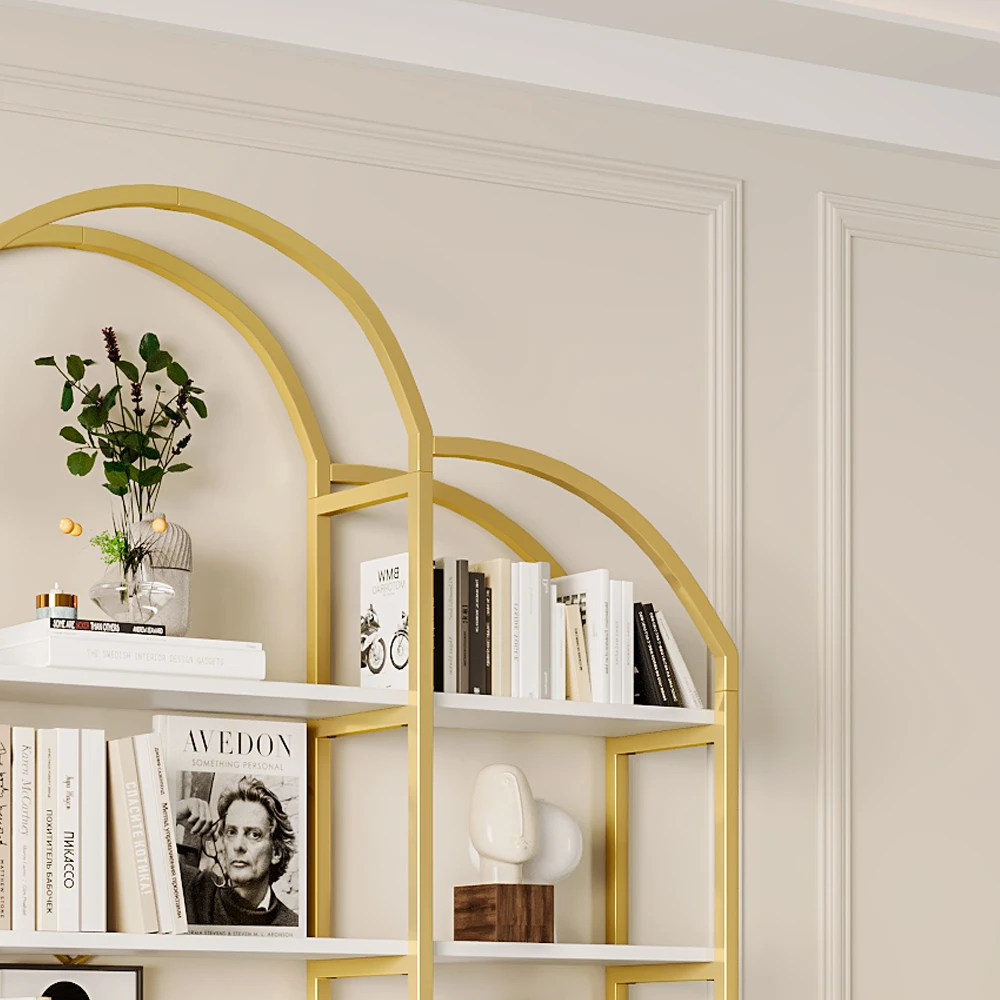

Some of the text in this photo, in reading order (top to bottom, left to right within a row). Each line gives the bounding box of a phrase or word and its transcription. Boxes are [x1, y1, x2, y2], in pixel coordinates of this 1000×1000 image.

[21, 744, 32, 775] Karen
[183, 729, 293, 758] AVEDON
[191, 758, 284, 771] SOMETHING PERSONAL
[18, 779, 32, 835] McCartney
[125, 781, 152, 895] СПАСИТЕ КОТИКА!
[63, 831, 75, 889] ПИКАССО
